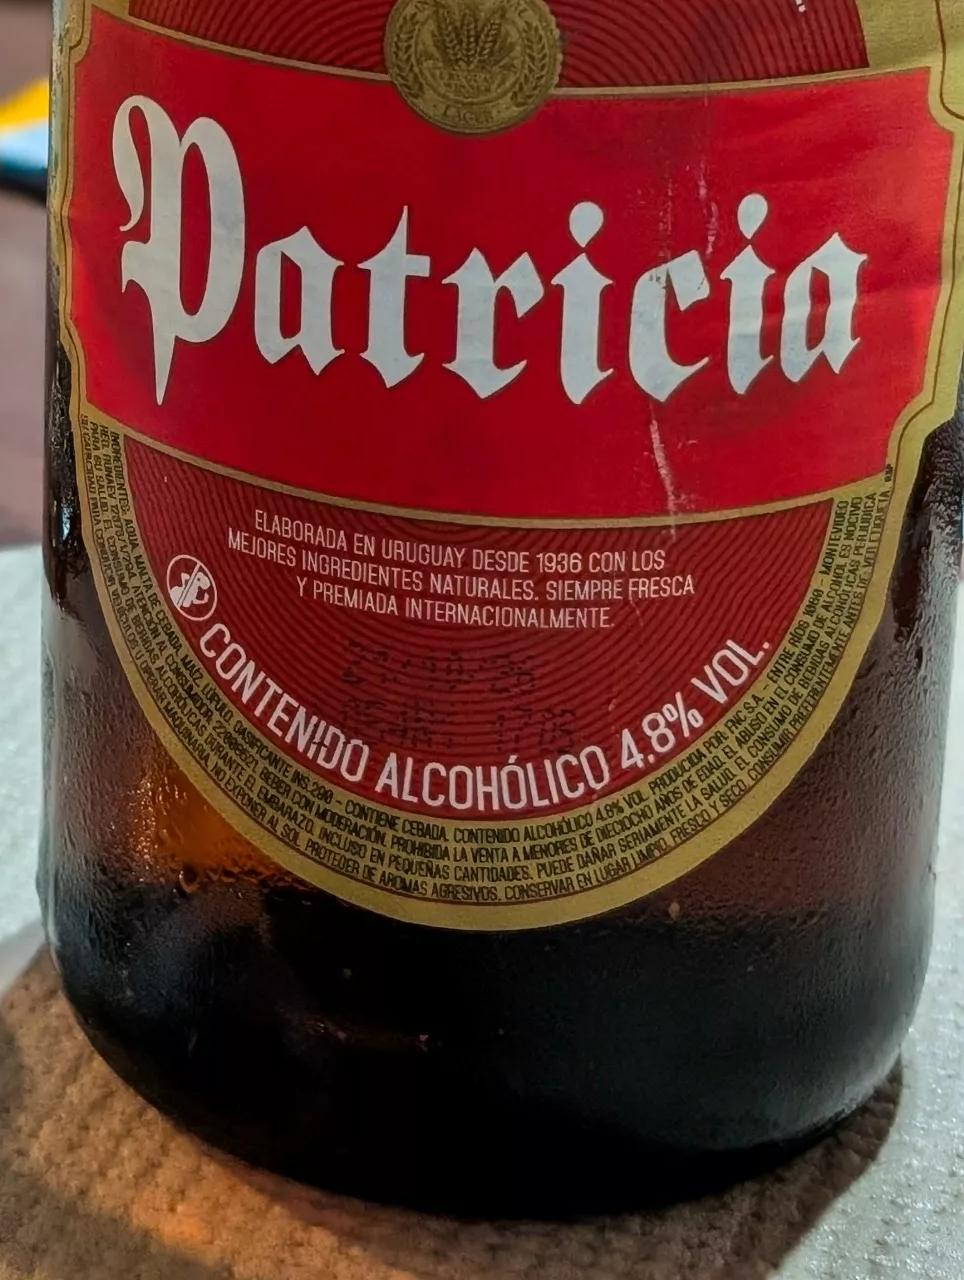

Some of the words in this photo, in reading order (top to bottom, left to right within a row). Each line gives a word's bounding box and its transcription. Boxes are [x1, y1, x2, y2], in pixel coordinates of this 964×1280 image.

[112, 95, 868, 405] Patricia
[843, 496, 862, 540] NOCIVO
[255, 509, 348, 552] ELABORADA
[353, 533, 376, 557] EN
[381, 538, 466, 569] URUGUAY
[472, 549, 530, 573] DESDE
[536, 552, 582, 573] 1936
[588, 551, 626, 573] CON
[631, 550, 666, 572] LOS
[838, 544, 852, 558] ES
[228, 527, 297, 568] MEJORES
[302, 549, 423, 592] INGREDIENTES
[430, 573, 539, 601] NATURALES.
[546, 579, 623, 601] SIEMPRE
[628, 574, 695, 600] FRESCA
[820, 562, 846, 612] ALCOHOL
[131, 585, 160, 639] ATENCIÓN
[296, 575, 308, 597] Y
[313, 580, 398, 616] PREMIADA
[405, 596, 615, 629] INTERNACIONALMENTE.
[812, 614, 828, 629] DE
[155, 640, 167, 655] AL
[783, 629, 819, 685] CONSUMO
[106, 535, 129, 595] CONSUMO
[125, 596, 137, 612] DE
[131, 613, 159, 664] BEBIDAS
[155, 665, 206, 736] ALCOHÓLICAS
[204, 732, 245, 781] DURANTE
[243, 773, 256, 792] EL
[318, 826, 367, 858] INCLUSO
[369, 847, 385, 866] EN
[387, 854, 449, 879] PEQUEÑAS
[536, 855, 574, 878] PUEDE
[576, 843, 616, 869] DAÑAR
[617, 804, 685, 852] SERIAMENTE
[684, 794, 703, 812] LA
[733, 755, 750, 770] EL
[747, 705, 791, 757] CONSUMO
[787, 687, 803, 706] DE
[797, 640, 829, 689] BEBIDAS
[824, 559, 860, 639] ALCOHÓLICAS
[852, 492, 876, 555] PERJUDICA
[147, 592, 161, 609] DE
[233, 720, 292, 777] GASIFICANTE
[344, 799, 400, 831] CONTIENE
[453, 827, 519, 843] CONTENIDO
[523, 812, 593, 841] ALCOHÓLICO
[648, 748, 706, 794] PRODUCIDA
[766, 646, 795, 683] ENTRE
[818, 500, 848, 575] MONTEVIDEO
[761, 696, 779, 715] EN
[773, 685, 788, 700] EL
[200, 623, 371, 782] CONTENIDO
[374, 744, 610, 811] ALCOHÓLICO
[621, 692, 705, 771] 4.8%
[690, 639, 770, 704] VOL.
[735, 711, 767, 748] ABUSO
[224, 776, 266, 821] EXPONER
[266, 814, 278, 832] AL
[304, 838, 359, 874] PROTEGER
[362, 864, 377, 883] DE
[379, 870, 427, 895] AROMAS
[504, 876, 574, 902] CONSERVAR
[575, 871, 592, 888] EN
[593, 856, 631, 882] LUGAR
[669, 809, 711, 844] FRESCO
[708, 800, 719, 814] Y
[747, 728, 794, 780] CONSUMIR
[842, 591, 864, 629] ANTES
[721, 744, 738, 759] EL
[259, 766, 291, 798] BEBER
[681, 774, 698, 793] DE
[290, 790, 315, 814] CON
[654, 786, 683, 813] AÑOS
[595, 804, 653, 842] DIECIOCHO
[390, 834, 449, 860] PROHIBIDA
[522, 837, 577, 860] MENORES
[578, 830, 594, 848] DE
[453, 846, 467, 862] LA
[471, 847, 508, 863] VENTA
[512, 846, 520, 862] A
